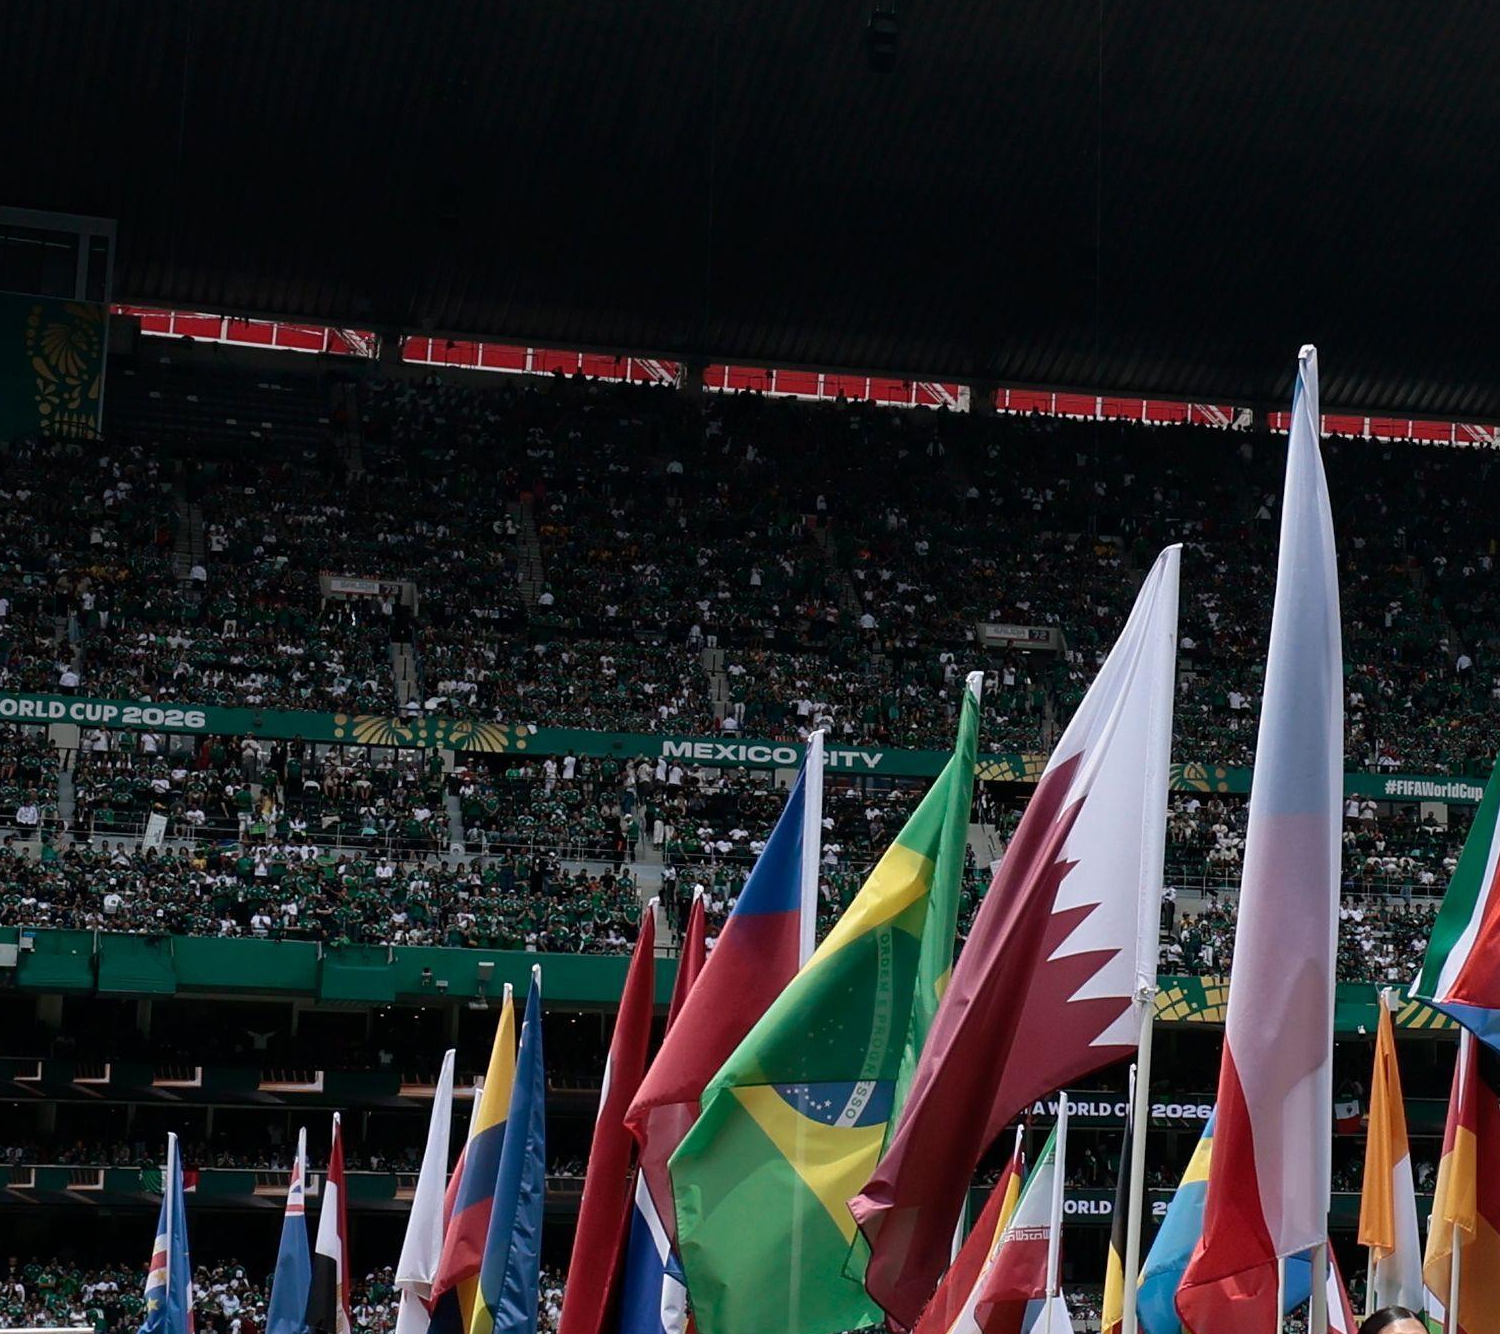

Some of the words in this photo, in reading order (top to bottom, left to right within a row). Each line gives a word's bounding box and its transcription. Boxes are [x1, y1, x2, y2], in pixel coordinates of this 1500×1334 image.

[70, 703, 118, 722] CUP
[122, 706, 206, 728] 2026
[662, 740, 797, 764] MEXICO
[1385, 779, 1483, 802] #FIFAWorldCup
[1151, 1103, 1213, 1118] 2026
[1064, 1200, 1111, 1214] ORLD
